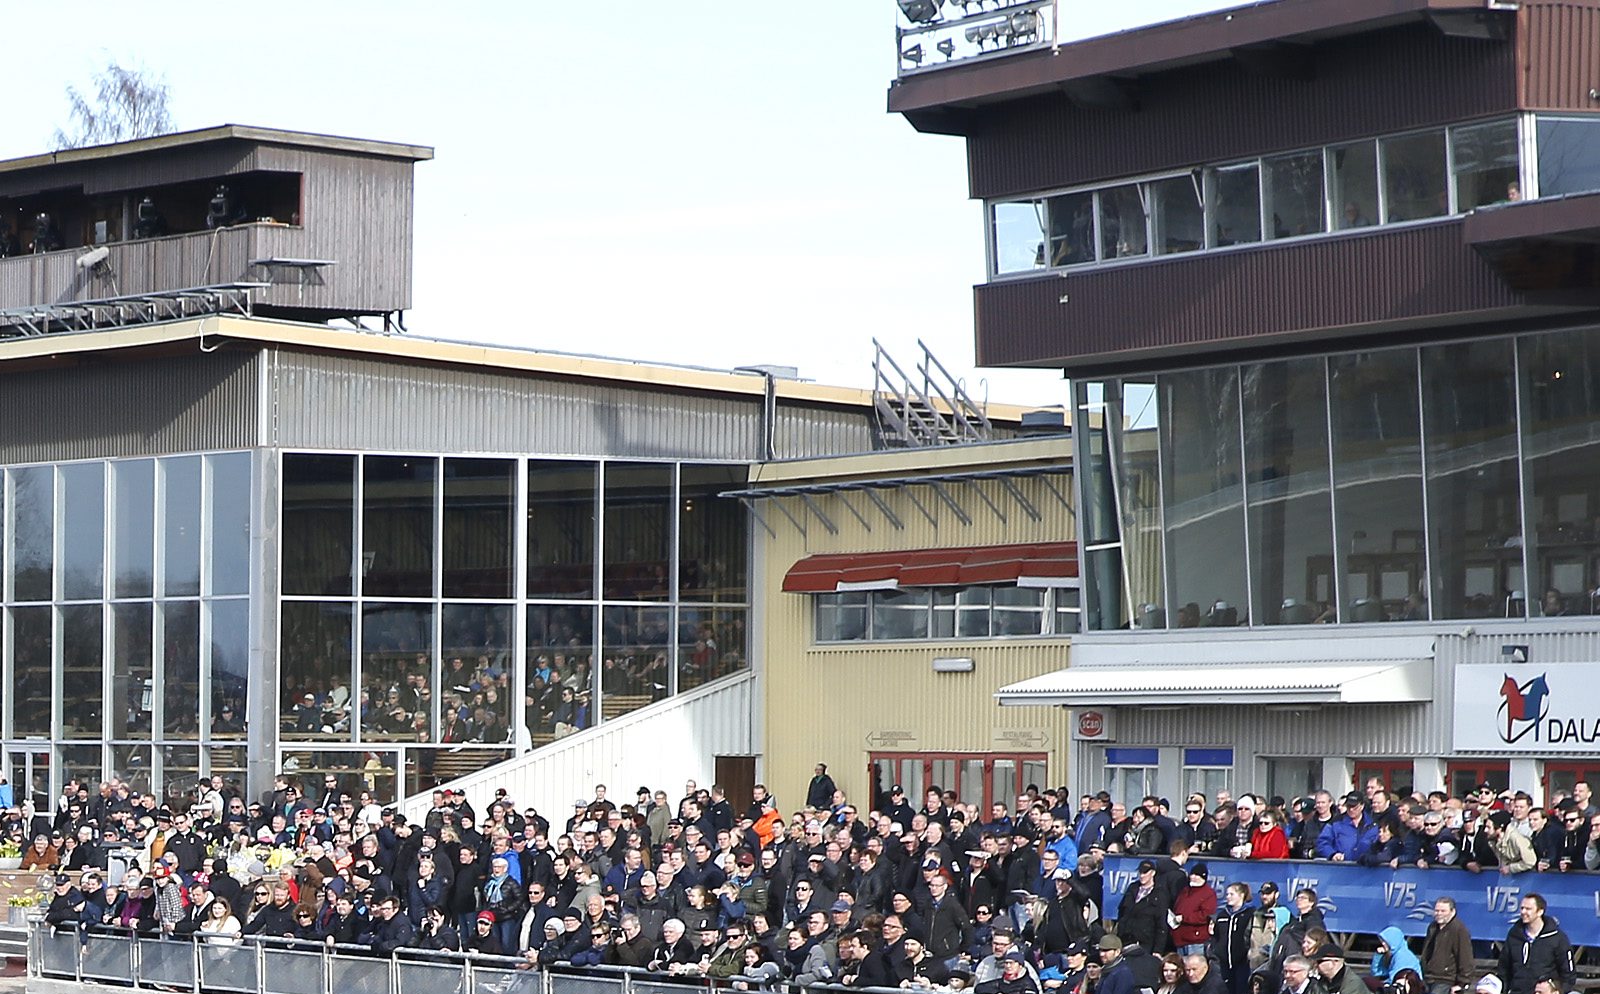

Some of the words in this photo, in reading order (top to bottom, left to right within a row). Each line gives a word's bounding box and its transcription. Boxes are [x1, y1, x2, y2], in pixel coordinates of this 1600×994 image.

[1207, 875, 1225, 899] 75
[1384, 882, 1417, 908] V75
[1487, 886, 1520, 912] V75
